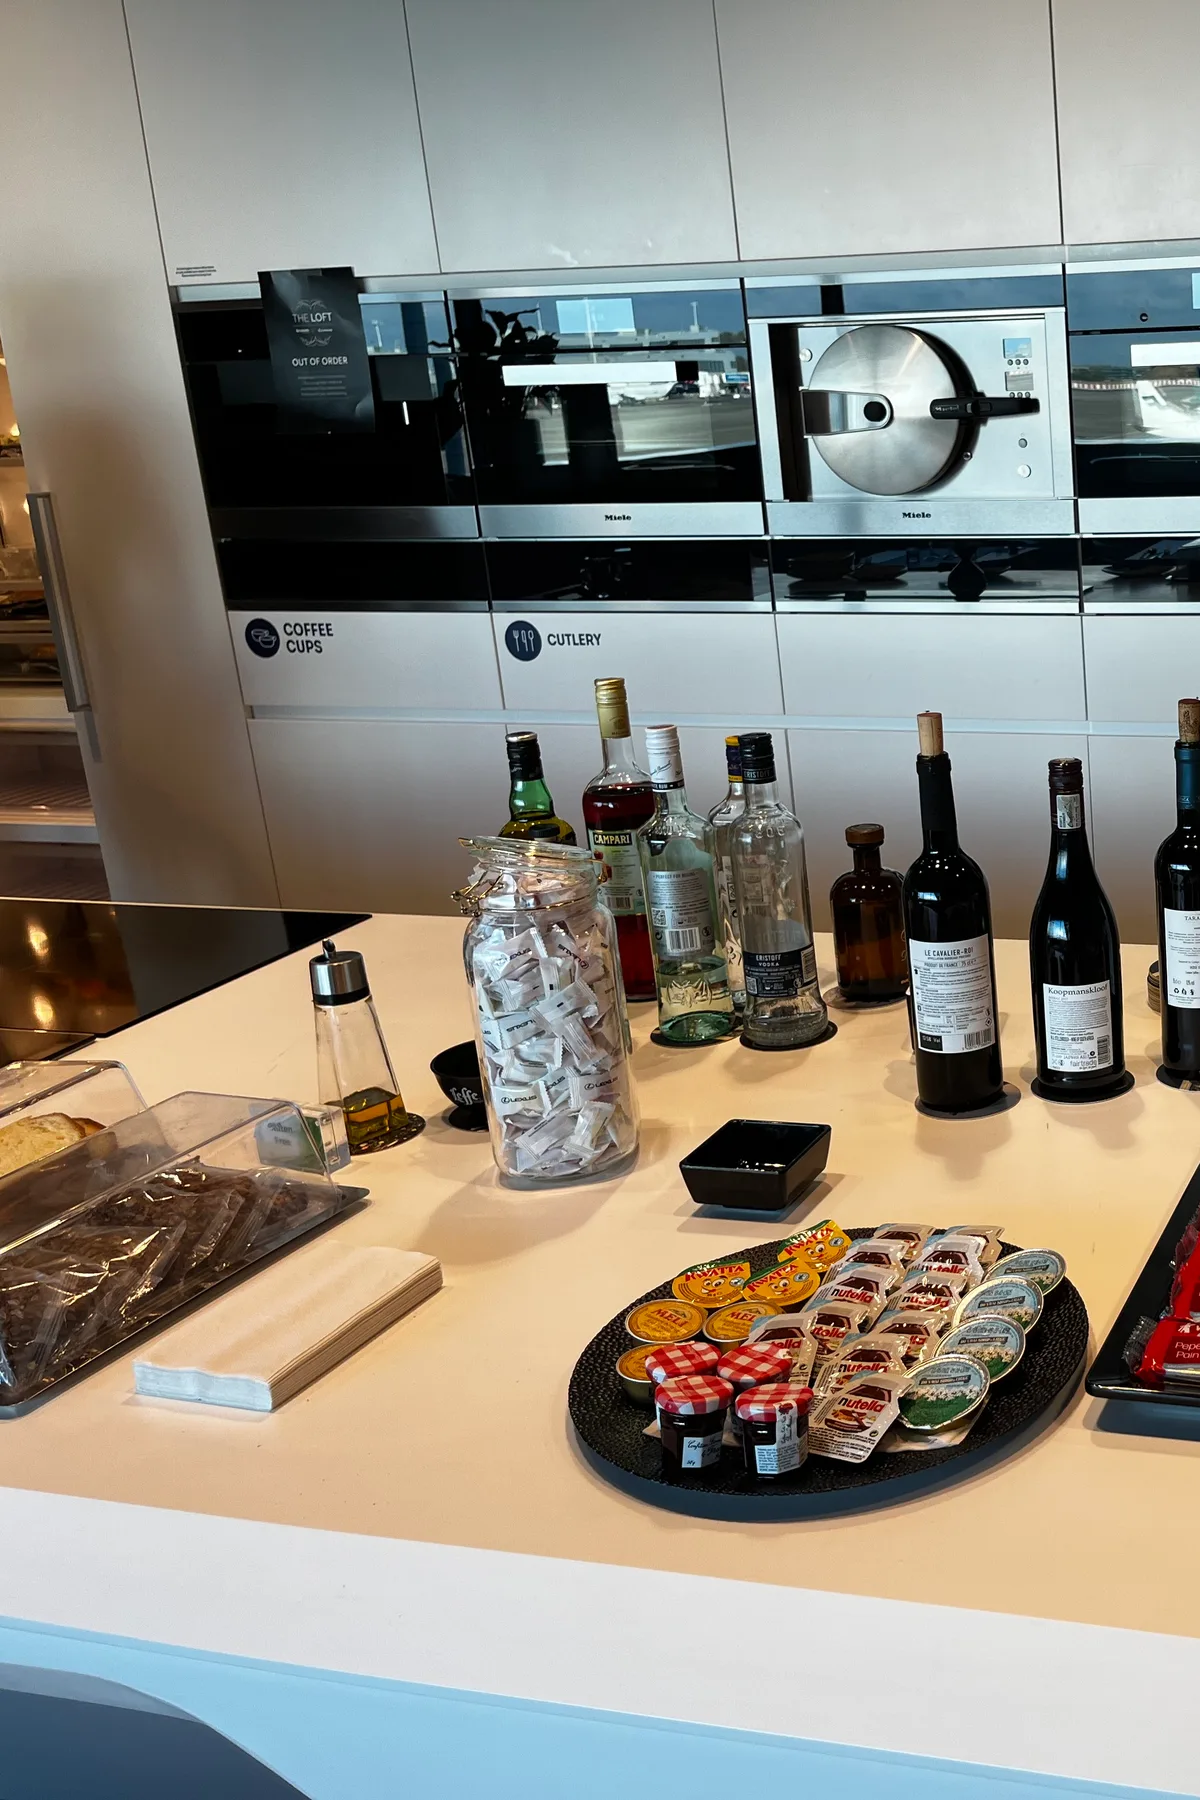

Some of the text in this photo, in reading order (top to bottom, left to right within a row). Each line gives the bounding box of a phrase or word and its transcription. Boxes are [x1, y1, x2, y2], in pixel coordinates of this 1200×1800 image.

[291, 312, 332, 323] THE LOFT
[292, 356, 348, 367] OUT OF ORDER
[604, 513, 632, 522] Miele
[902, 511, 932, 519] Miele
[283, 622, 334, 637] COFFEE
[286, 639, 323, 654] CUPS
[547, 633, 602, 647] CUTLERY
[594, 834, 630, 845] CAMPARI
[932, 946, 974, 957] CAVALIER-ROI
[1048, 983, 1108, 997] Koopmanskloof
[506, 1019, 534, 1033] LEXUS
[508, 1094, 538, 1104] LEXUS
[785, 1226, 834, 1256] KWATTA
[685, 1265, 745, 1282] KWATTA
[746, 1263, 798, 1293] KWATTA
[831, 1287, 874, 1305] nutella
[902, 1295, 950, 1308] nutella
[651, 1308, 689, 1327] MELI
[727, 1311, 755, 1323] MEL
[770, 1338, 802, 1349] tella
[1175, 1351, 1200, 1359] Pain
[839, 1363, 889, 1373] nutella
[837, 1397, 887, 1413] nutella
